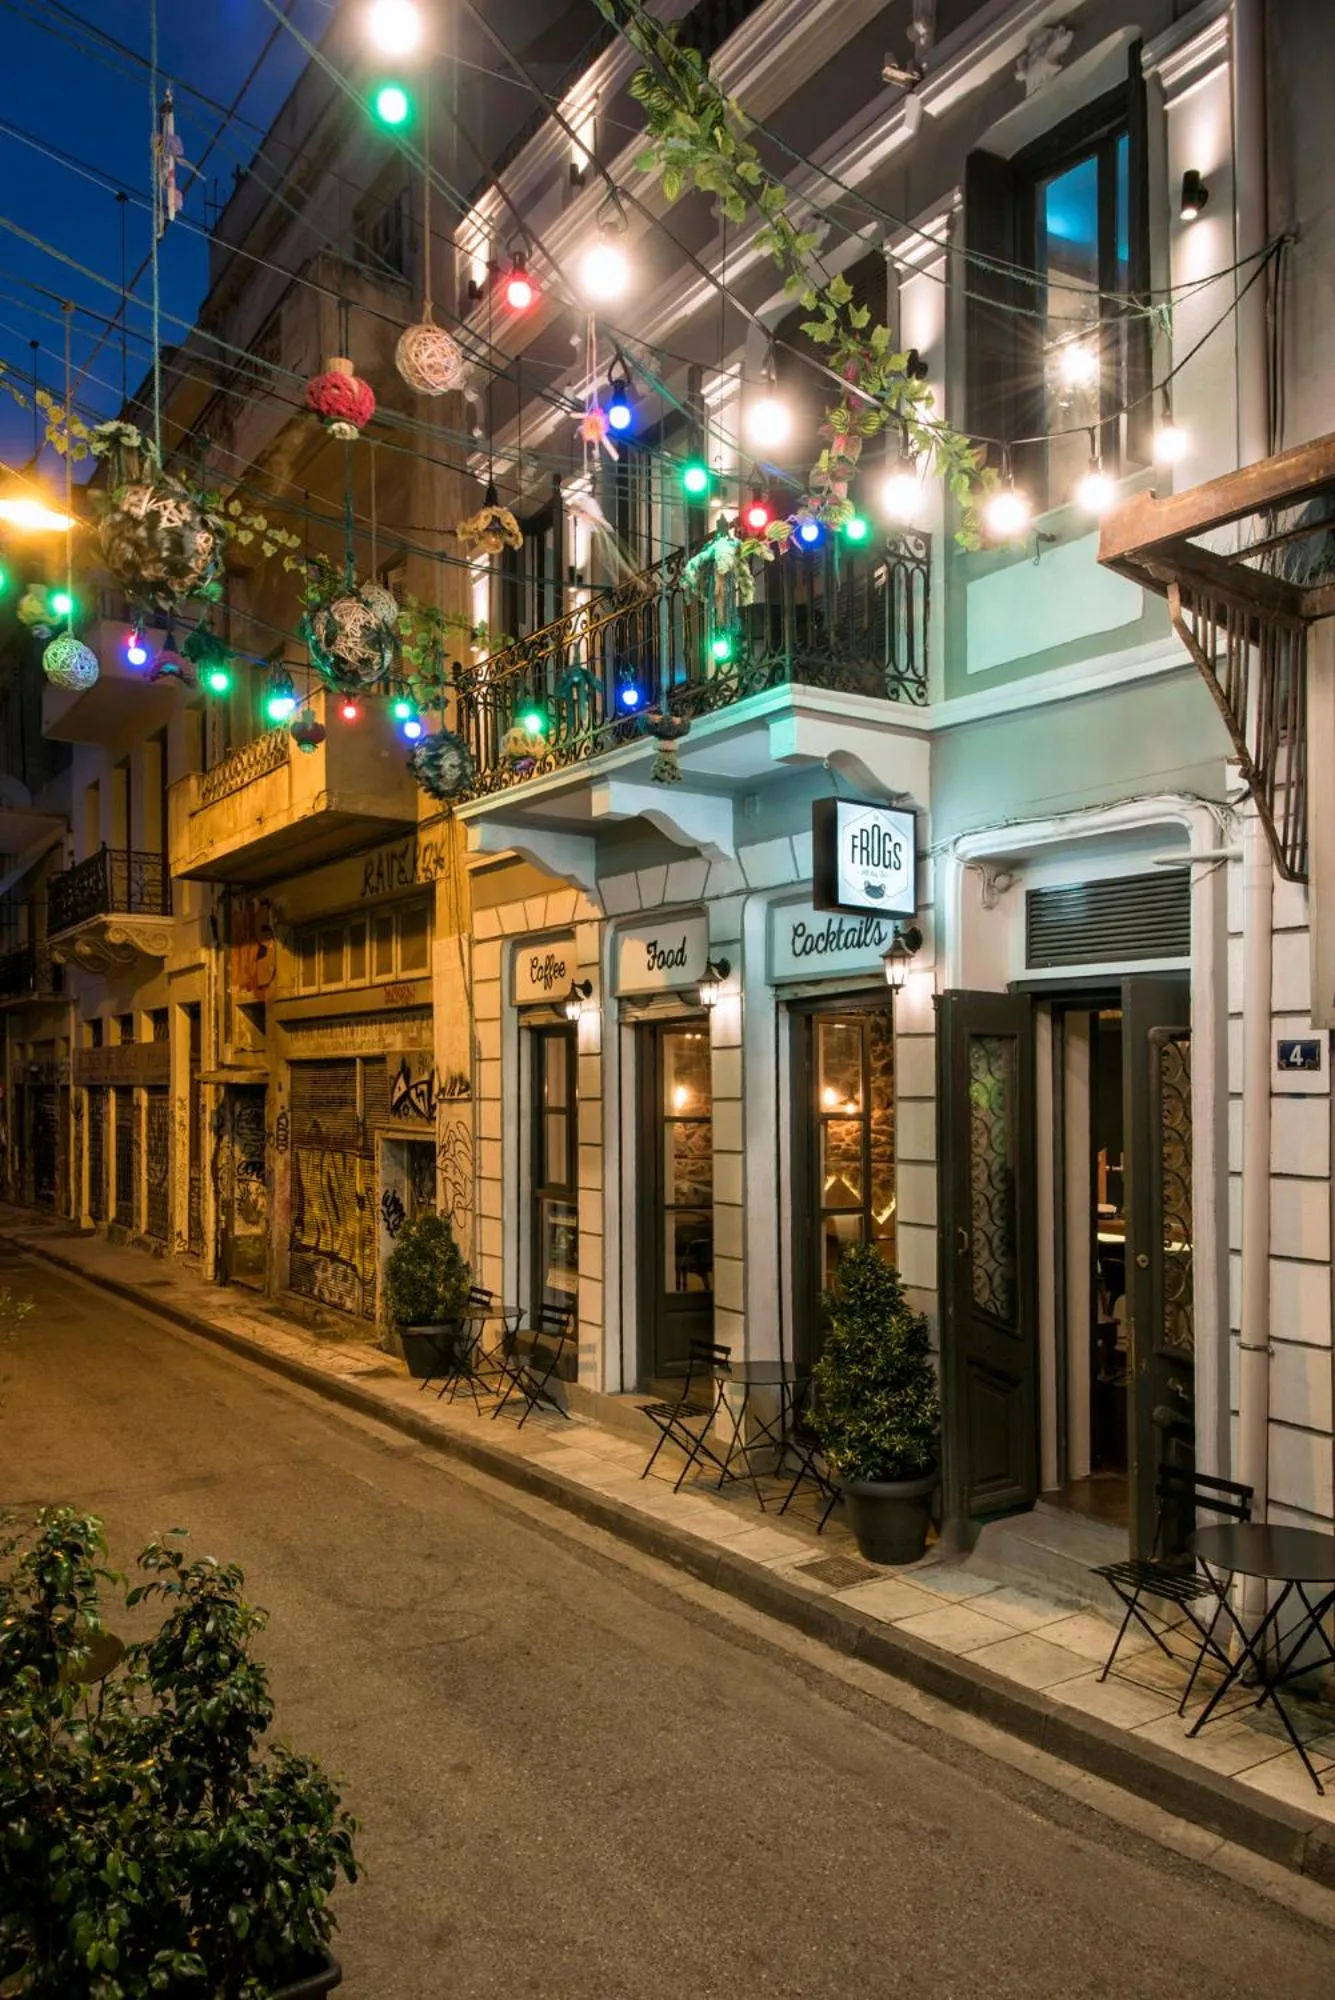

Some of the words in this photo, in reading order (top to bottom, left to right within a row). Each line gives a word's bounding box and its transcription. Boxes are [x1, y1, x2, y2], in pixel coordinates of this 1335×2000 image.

[851, 824, 902, 871] FROGS
[646, 936, 688, 971] Food
[792, 917, 888, 957] Cocktails
[530, 953, 566, 991] Coffee
[1290, 1044, 1304, 1066] 4
